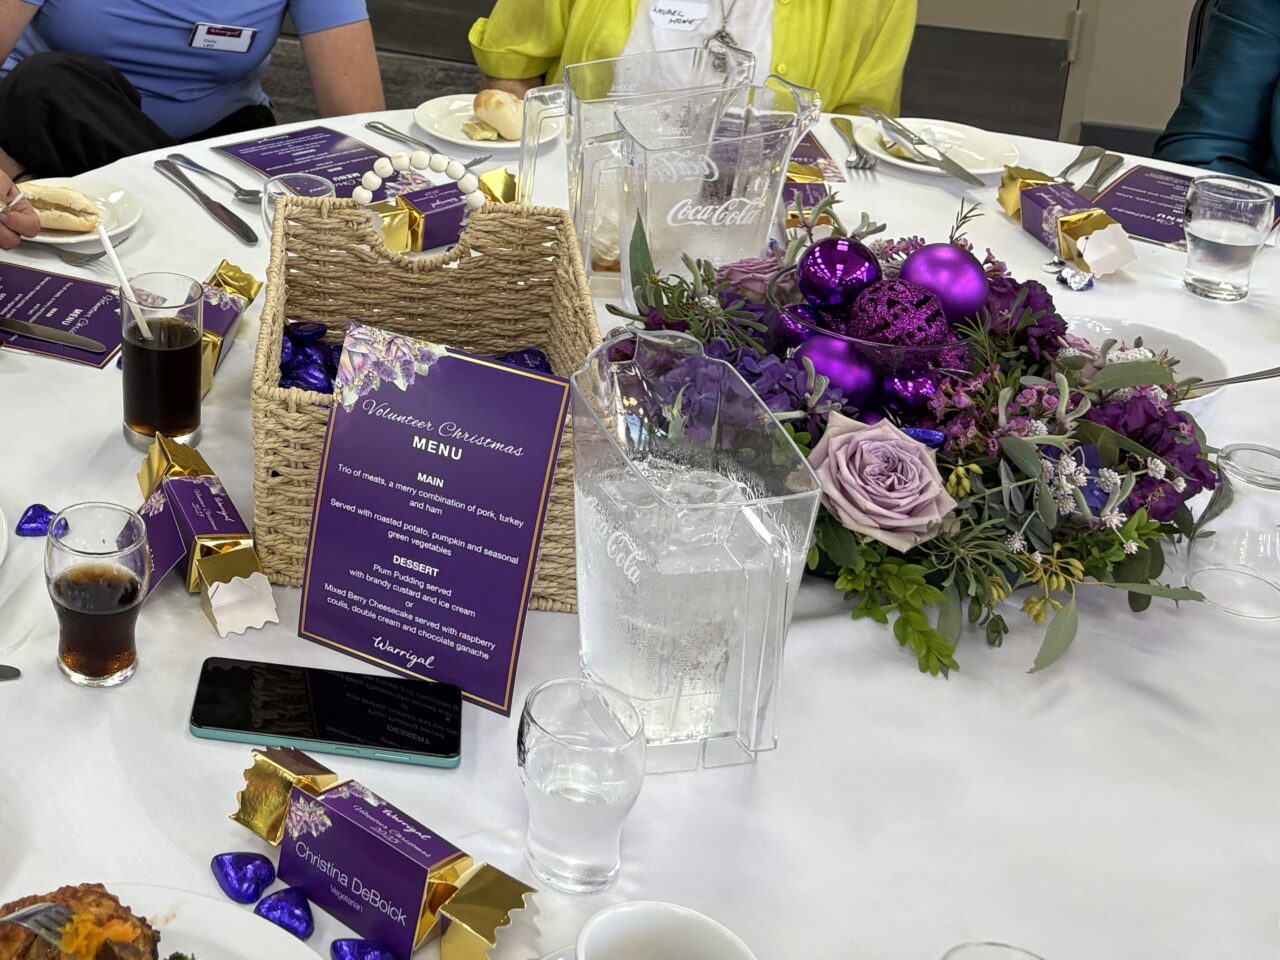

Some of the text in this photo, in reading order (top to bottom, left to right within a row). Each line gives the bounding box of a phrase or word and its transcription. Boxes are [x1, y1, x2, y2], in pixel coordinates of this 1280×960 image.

[667, 197, 762, 227] Coca-Cola
[1156, 213, 1184, 223] ENU
[61, 308, 83, 326] MENU
[362, 398, 524, 457] Volunteer Christmas
[412, 435, 463, 461] MENU
[417, 472, 444, 488] MAIN
[338, 464, 352, 475] Trio
[362, 472, 387, 486] meats,
[395, 482, 417, 496] merry
[418, 490, 466, 510] combination
[467, 505, 476, 513] of
[476, 508, 497, 520] pork,
[499, 513, 524, 529] turkey
[409, 500, 443, 516] and ham
[330, 497, 519, 565] Served with roasted potato, pumpkin and seasonal
[387, 530, 452, 556] green vegetables
[372, 563, 452, 597] Plum Pudding served
[392, 555, 439, 577] DESSERT
[349, 569, 476, 618] with brandy custard and ice cream
[404, 600, 414, 608] or
[324, 582, 496, 651] Mixed Berry Cheesecake served with raspberry
[326, 596, 489, 660] coulis, double cream and chocolate ganache
[372, 636, 435, 669] Warrigal
[382, 807, 432, 841] Warrigal
[295, 841, 407, 927] Christina DeBoick
[330, 883, 363, 913] Vegetarian
